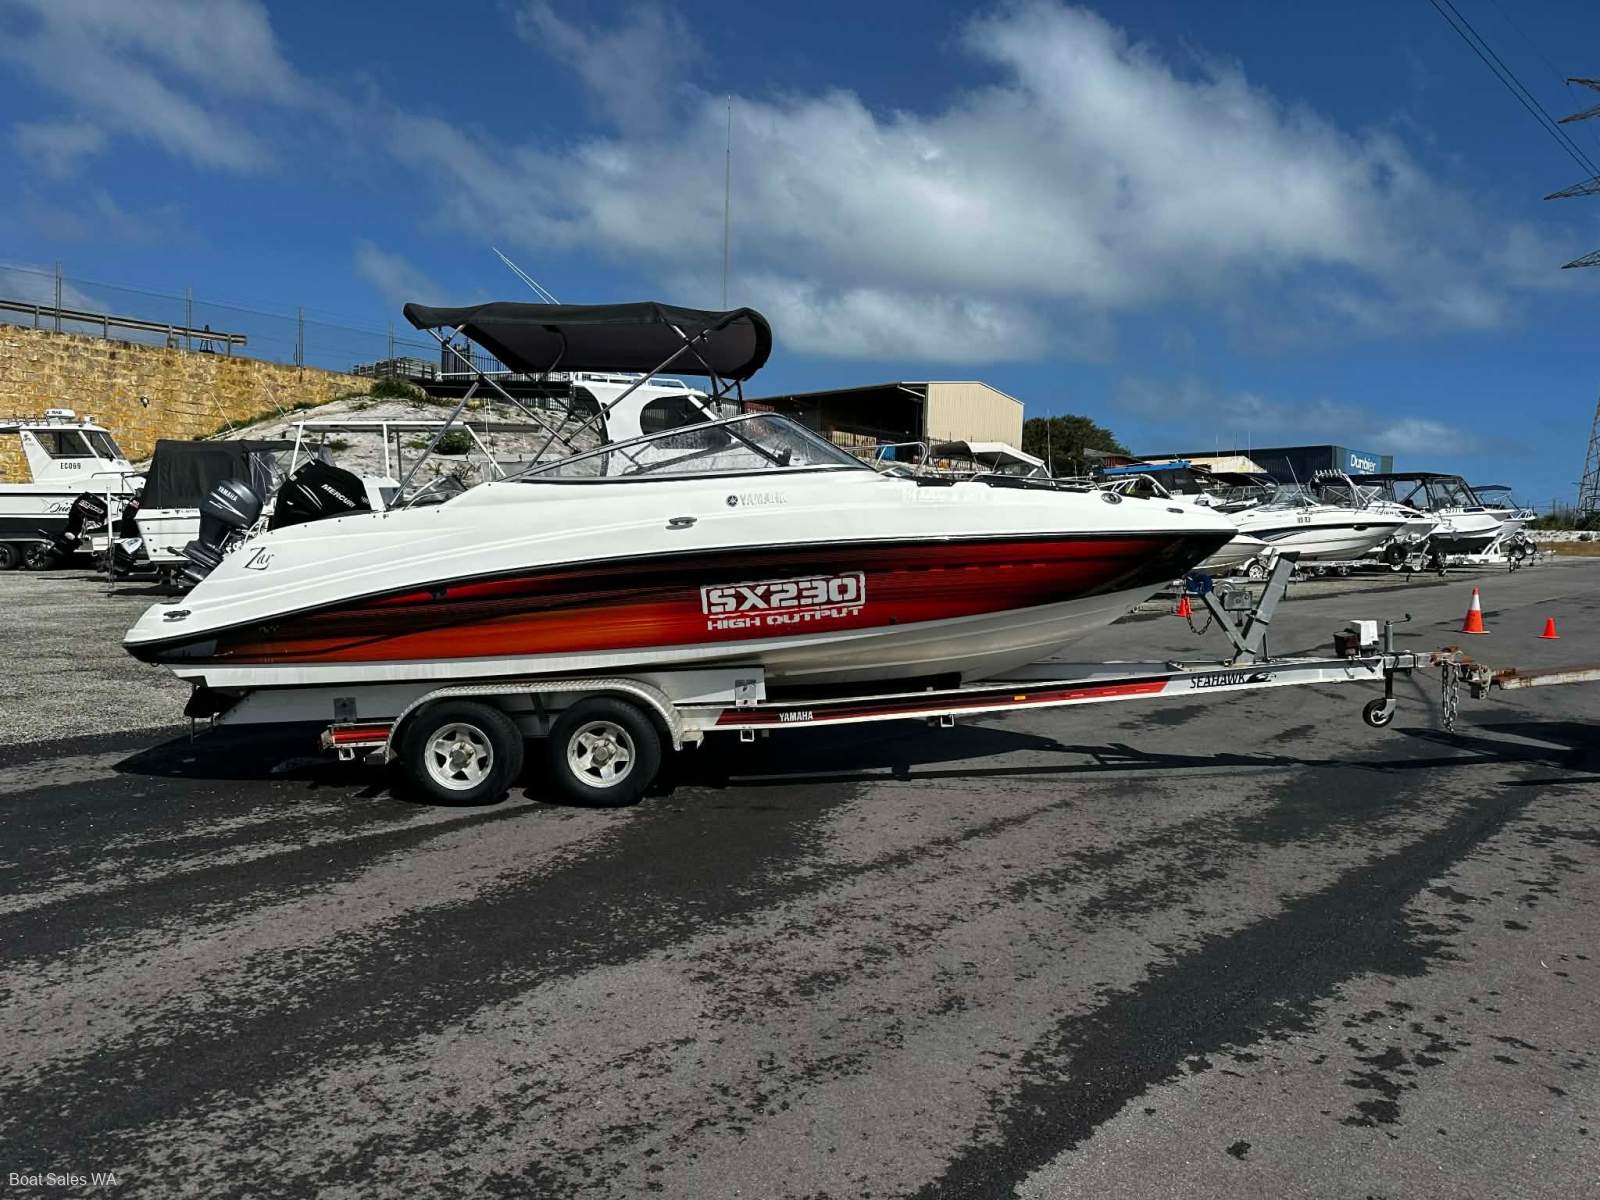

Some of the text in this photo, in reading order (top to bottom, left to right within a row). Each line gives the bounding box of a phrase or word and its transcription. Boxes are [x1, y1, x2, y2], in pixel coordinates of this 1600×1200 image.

[1350, 454, 1376, 472] Dunbier
[218, 486, 238, 501] YAMAHA
[709, 577, 857, 614] SX230
[707, 605, 864, 630] HIGH OUTPUT
[1190, 672, 1248, 688] SEAHAWK
[779, 711, 814, 722] YAMAHA
